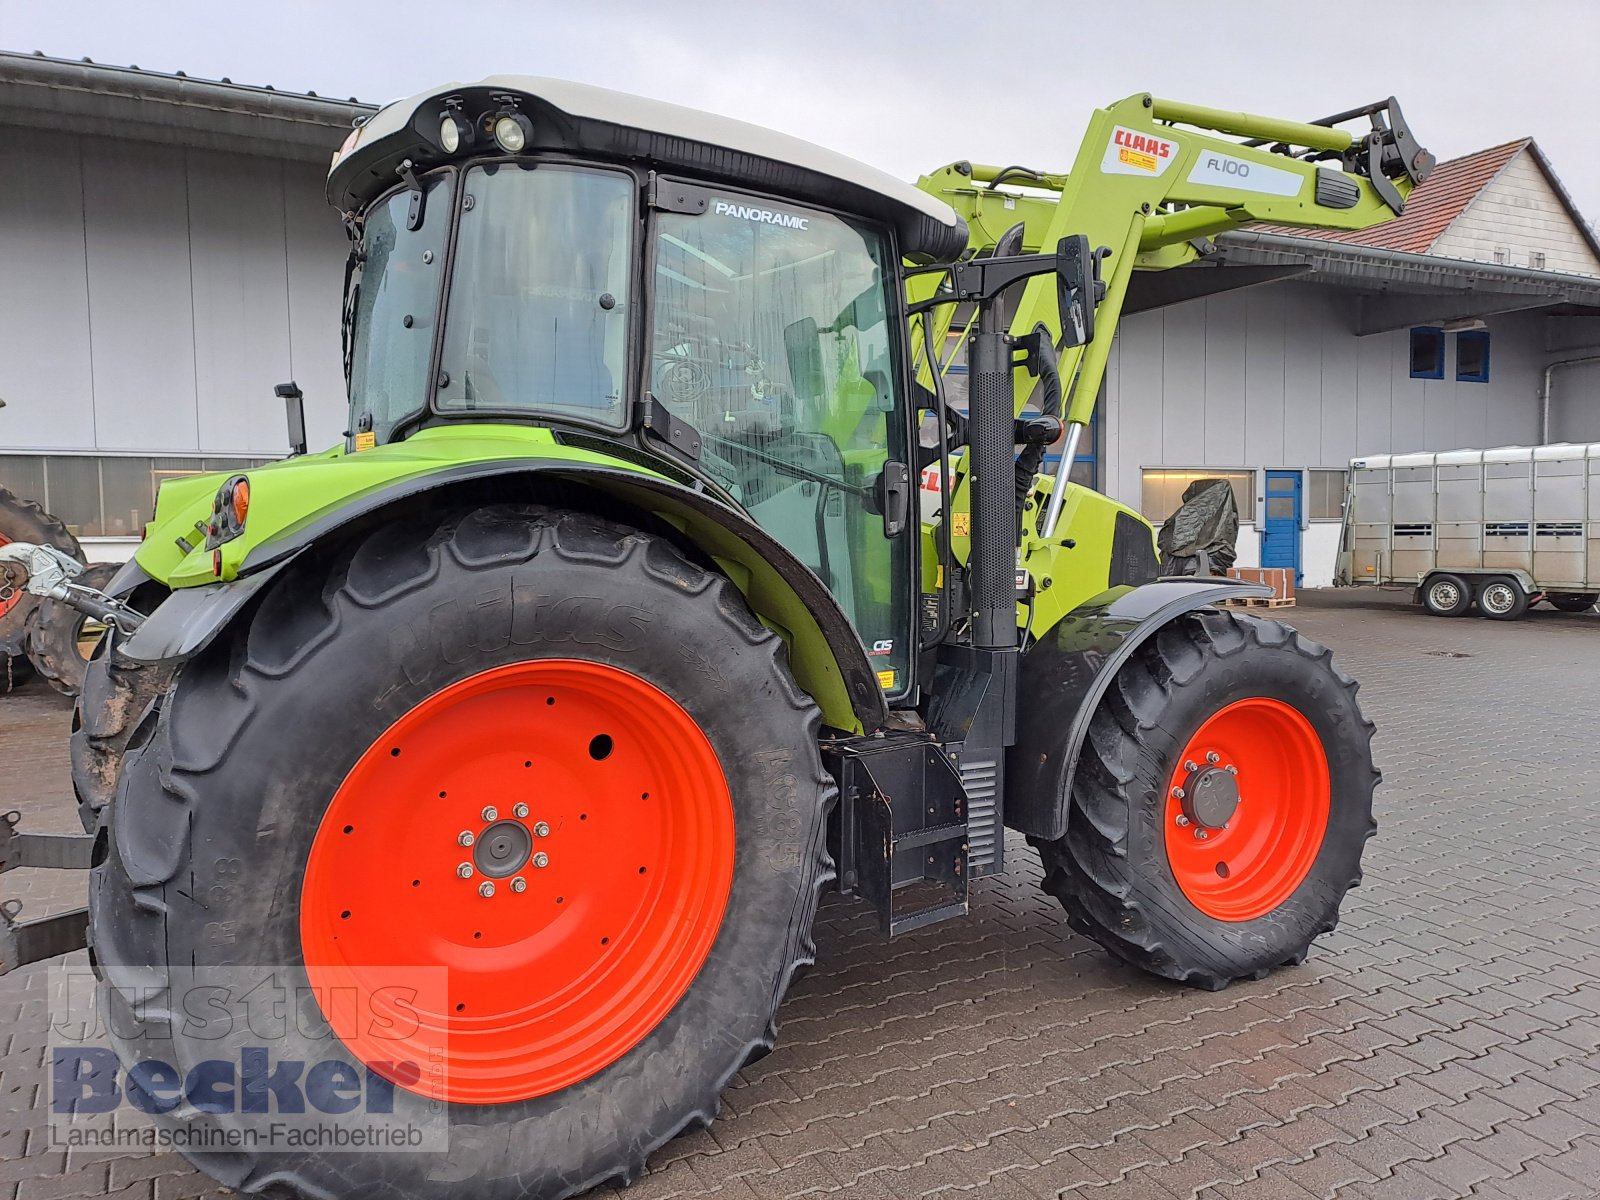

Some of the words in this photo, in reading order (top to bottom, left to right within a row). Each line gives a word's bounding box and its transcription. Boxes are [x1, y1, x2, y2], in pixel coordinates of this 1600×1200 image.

[1114, 130, 1170, 158] CLAAS
[715, 202, 809, 231] PANORAMIC
[873, 640, 893, 651] CIS
